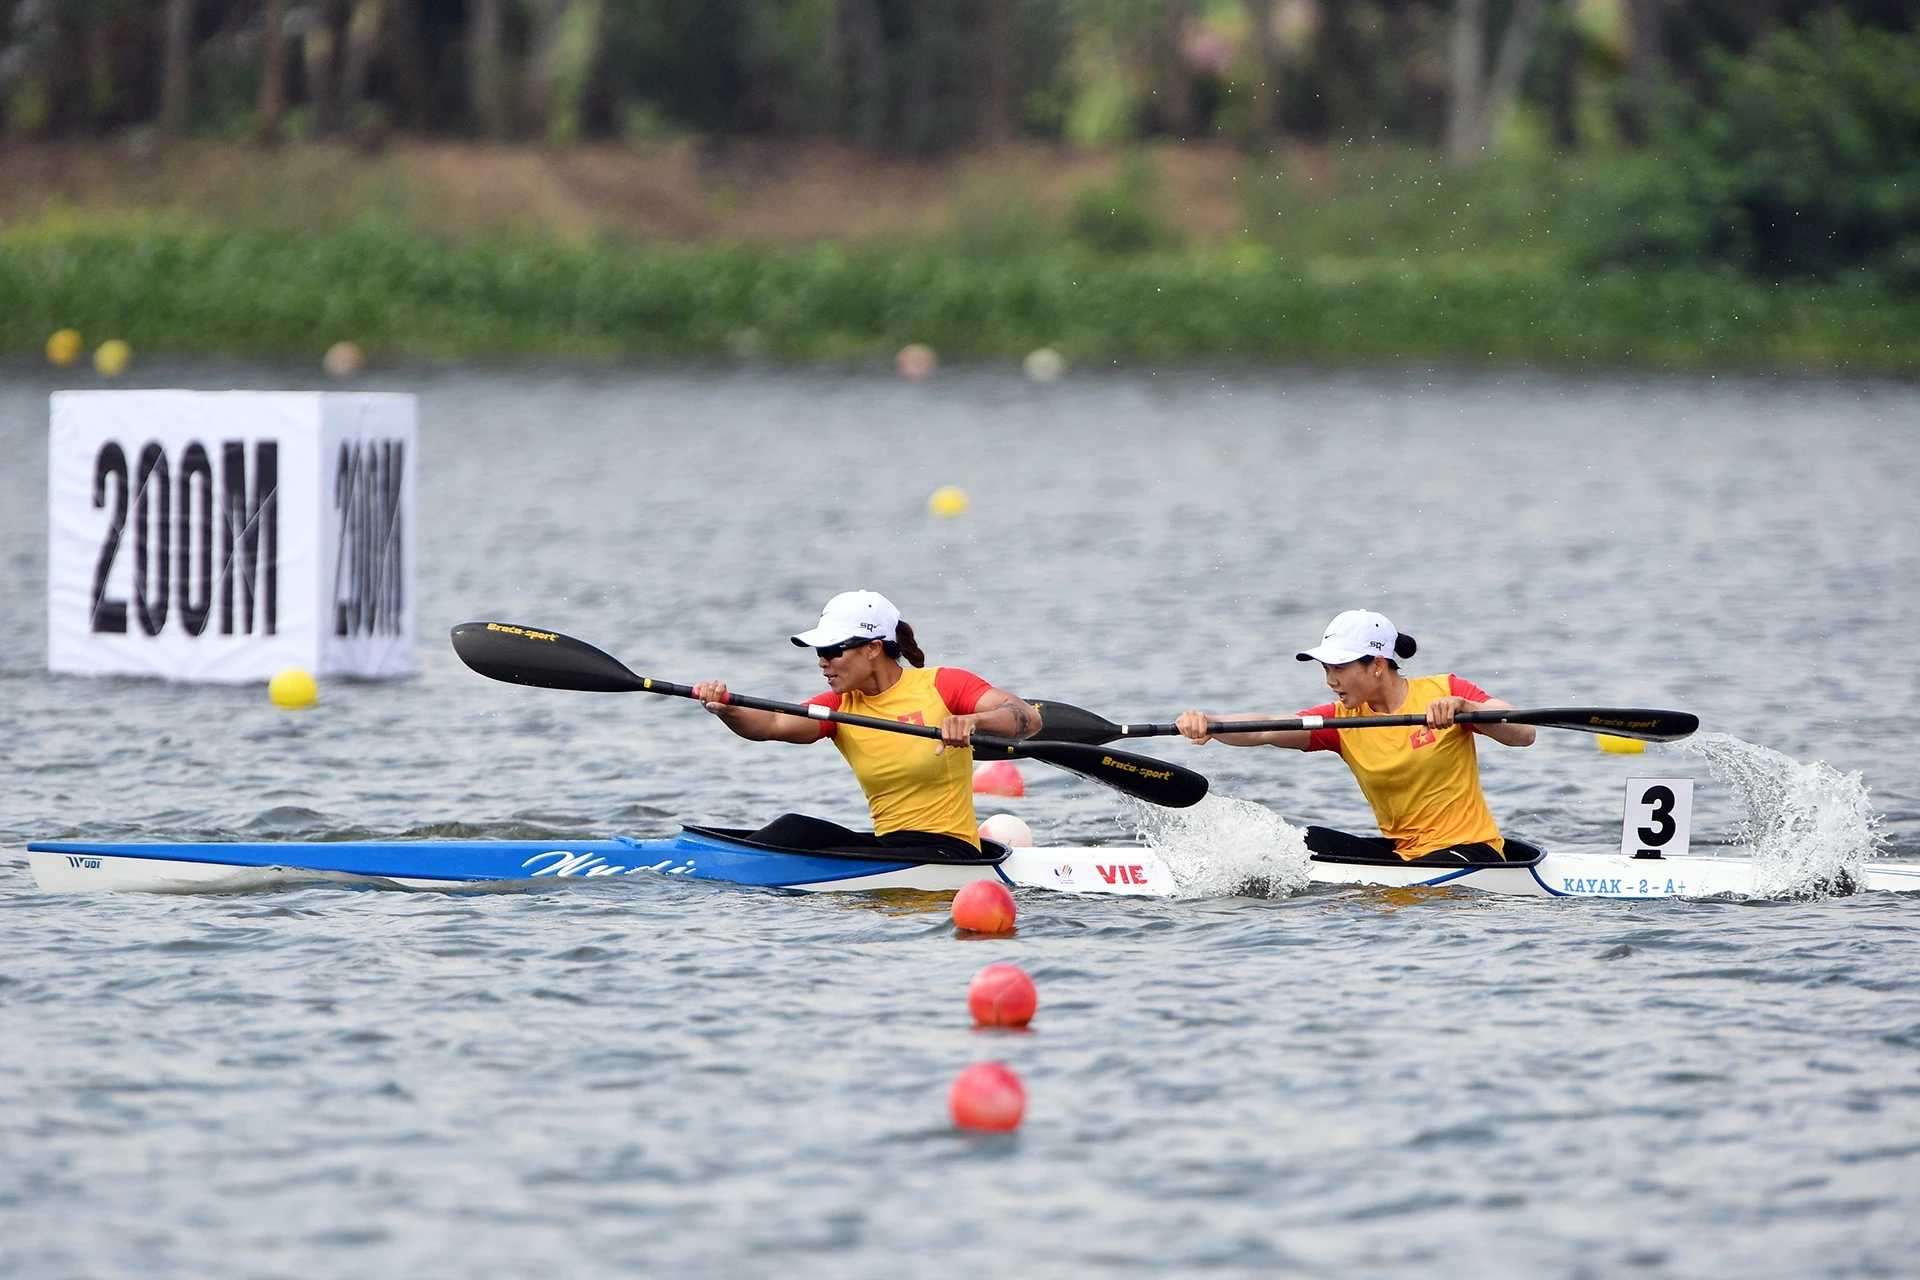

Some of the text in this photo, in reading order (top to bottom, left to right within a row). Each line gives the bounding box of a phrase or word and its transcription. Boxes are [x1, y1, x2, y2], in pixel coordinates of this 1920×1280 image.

[92, 440, 277, 635] 200M
[1637, 784, 1676, 846] 3
[1095, 865, 1148, 885] VIE
